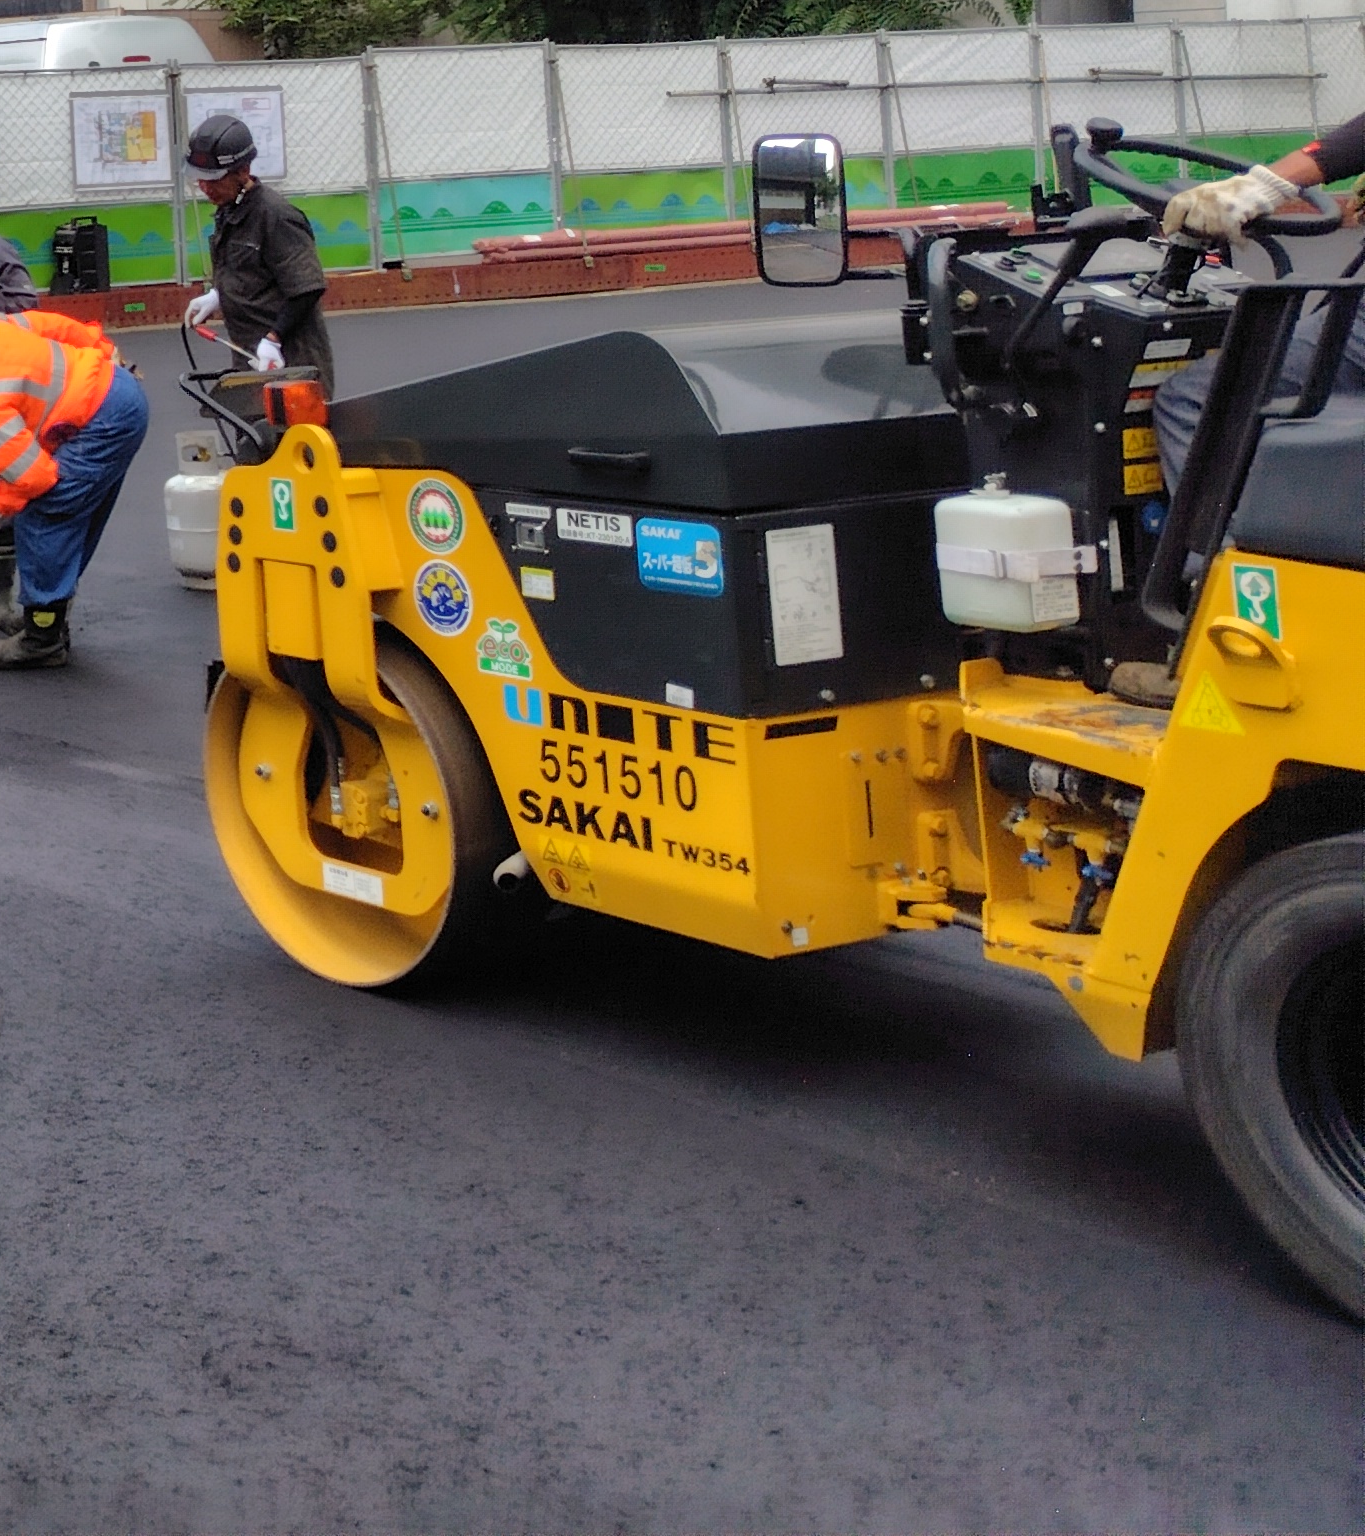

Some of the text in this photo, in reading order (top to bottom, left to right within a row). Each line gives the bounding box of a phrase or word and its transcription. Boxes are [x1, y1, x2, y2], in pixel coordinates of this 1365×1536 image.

[567, 511, 621, 533] NETIS
[641, 525, 683, 540] SAKAI
[491, 661, 519, 676] MODE
[540, 738, 698, 812] 551510
[518, 788, 751, 877] SAKAI TW354
